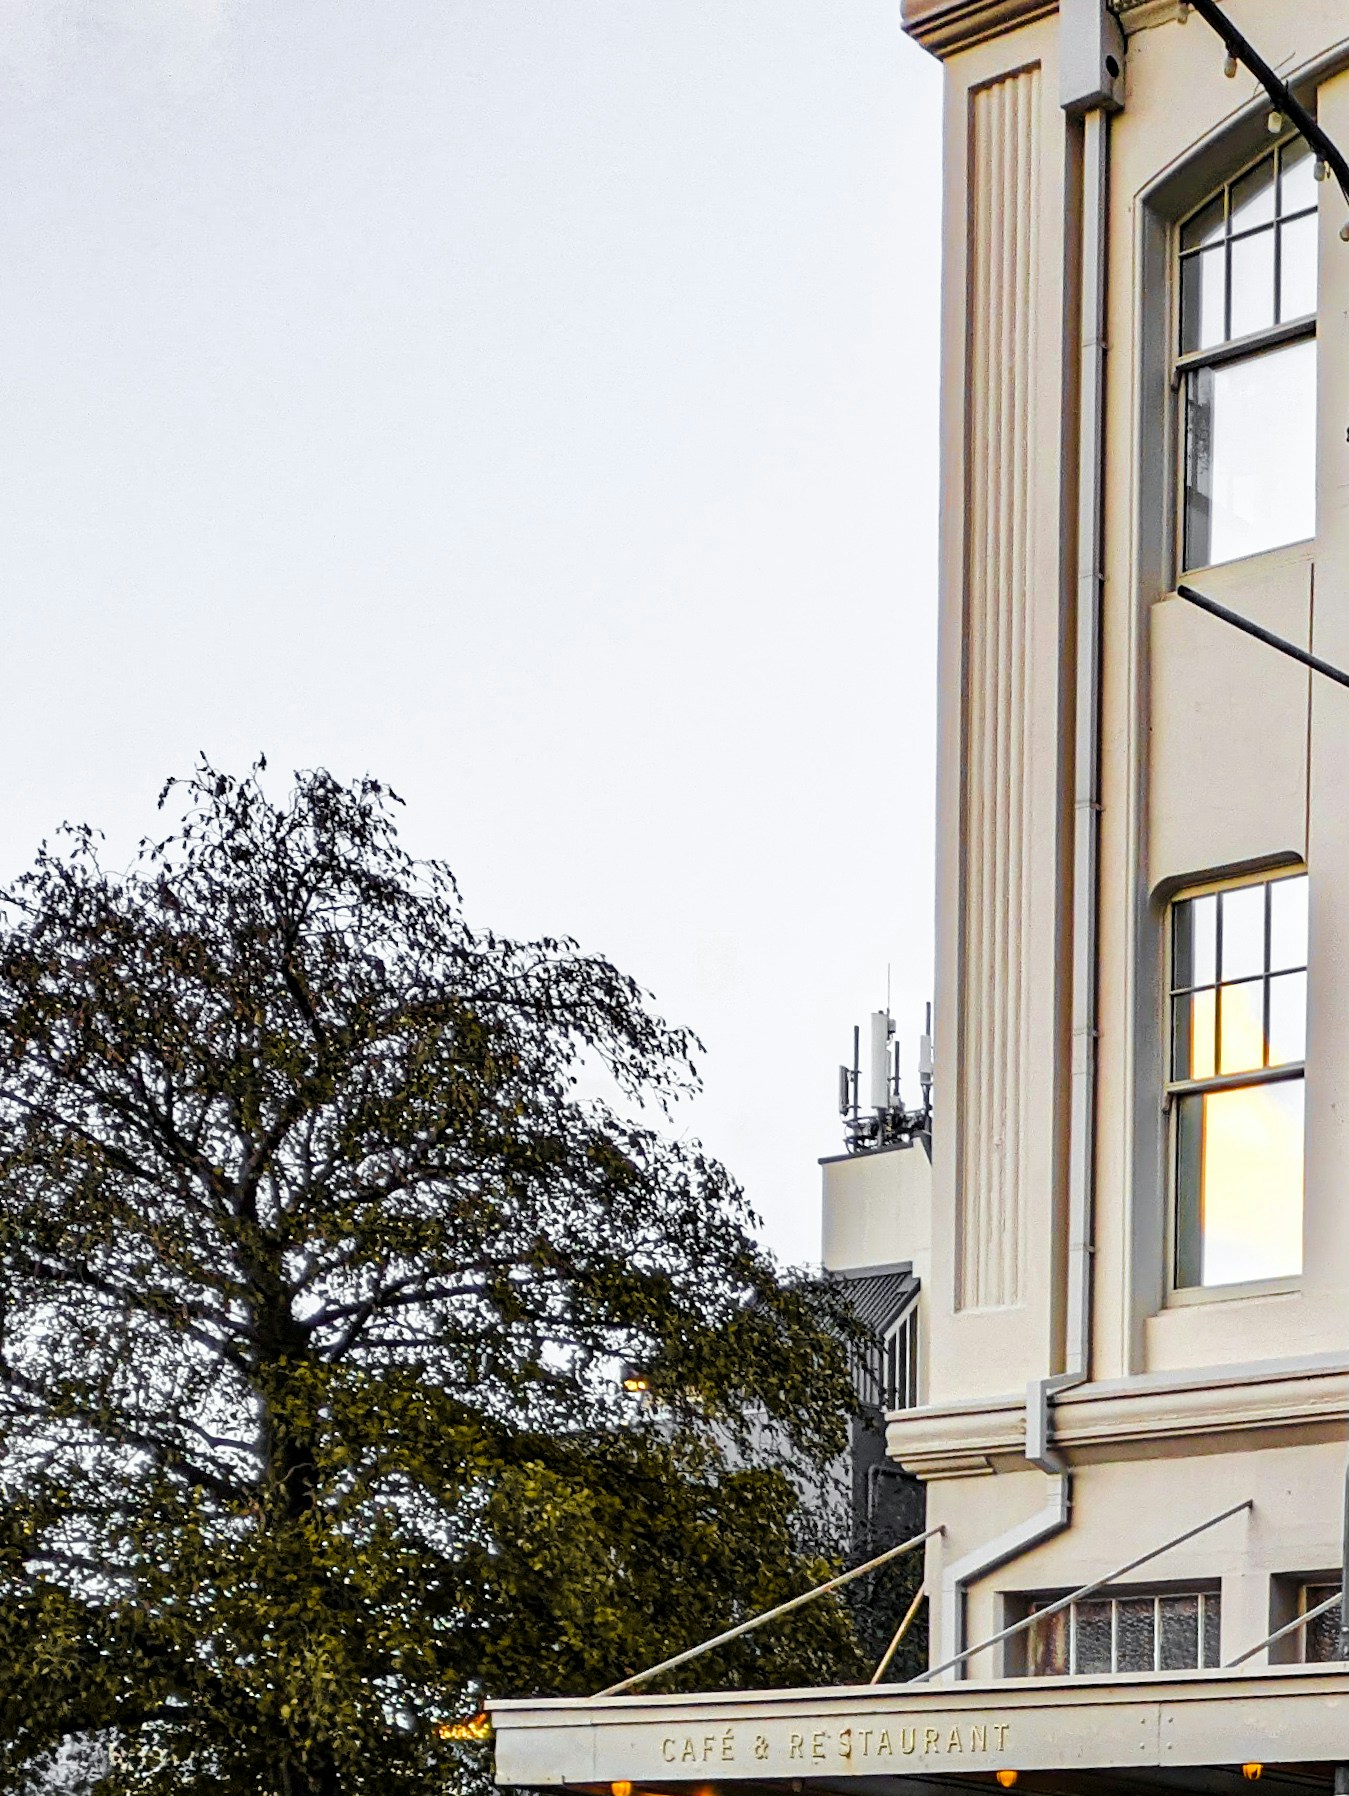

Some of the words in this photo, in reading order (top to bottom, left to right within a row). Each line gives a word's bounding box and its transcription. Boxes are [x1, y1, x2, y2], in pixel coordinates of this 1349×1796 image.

[661, 1728, 735, 1763] CAFÉ
[754, 1733, 770, 1760] &
[788, 1723, 1010, 1760] RESTAURANT
